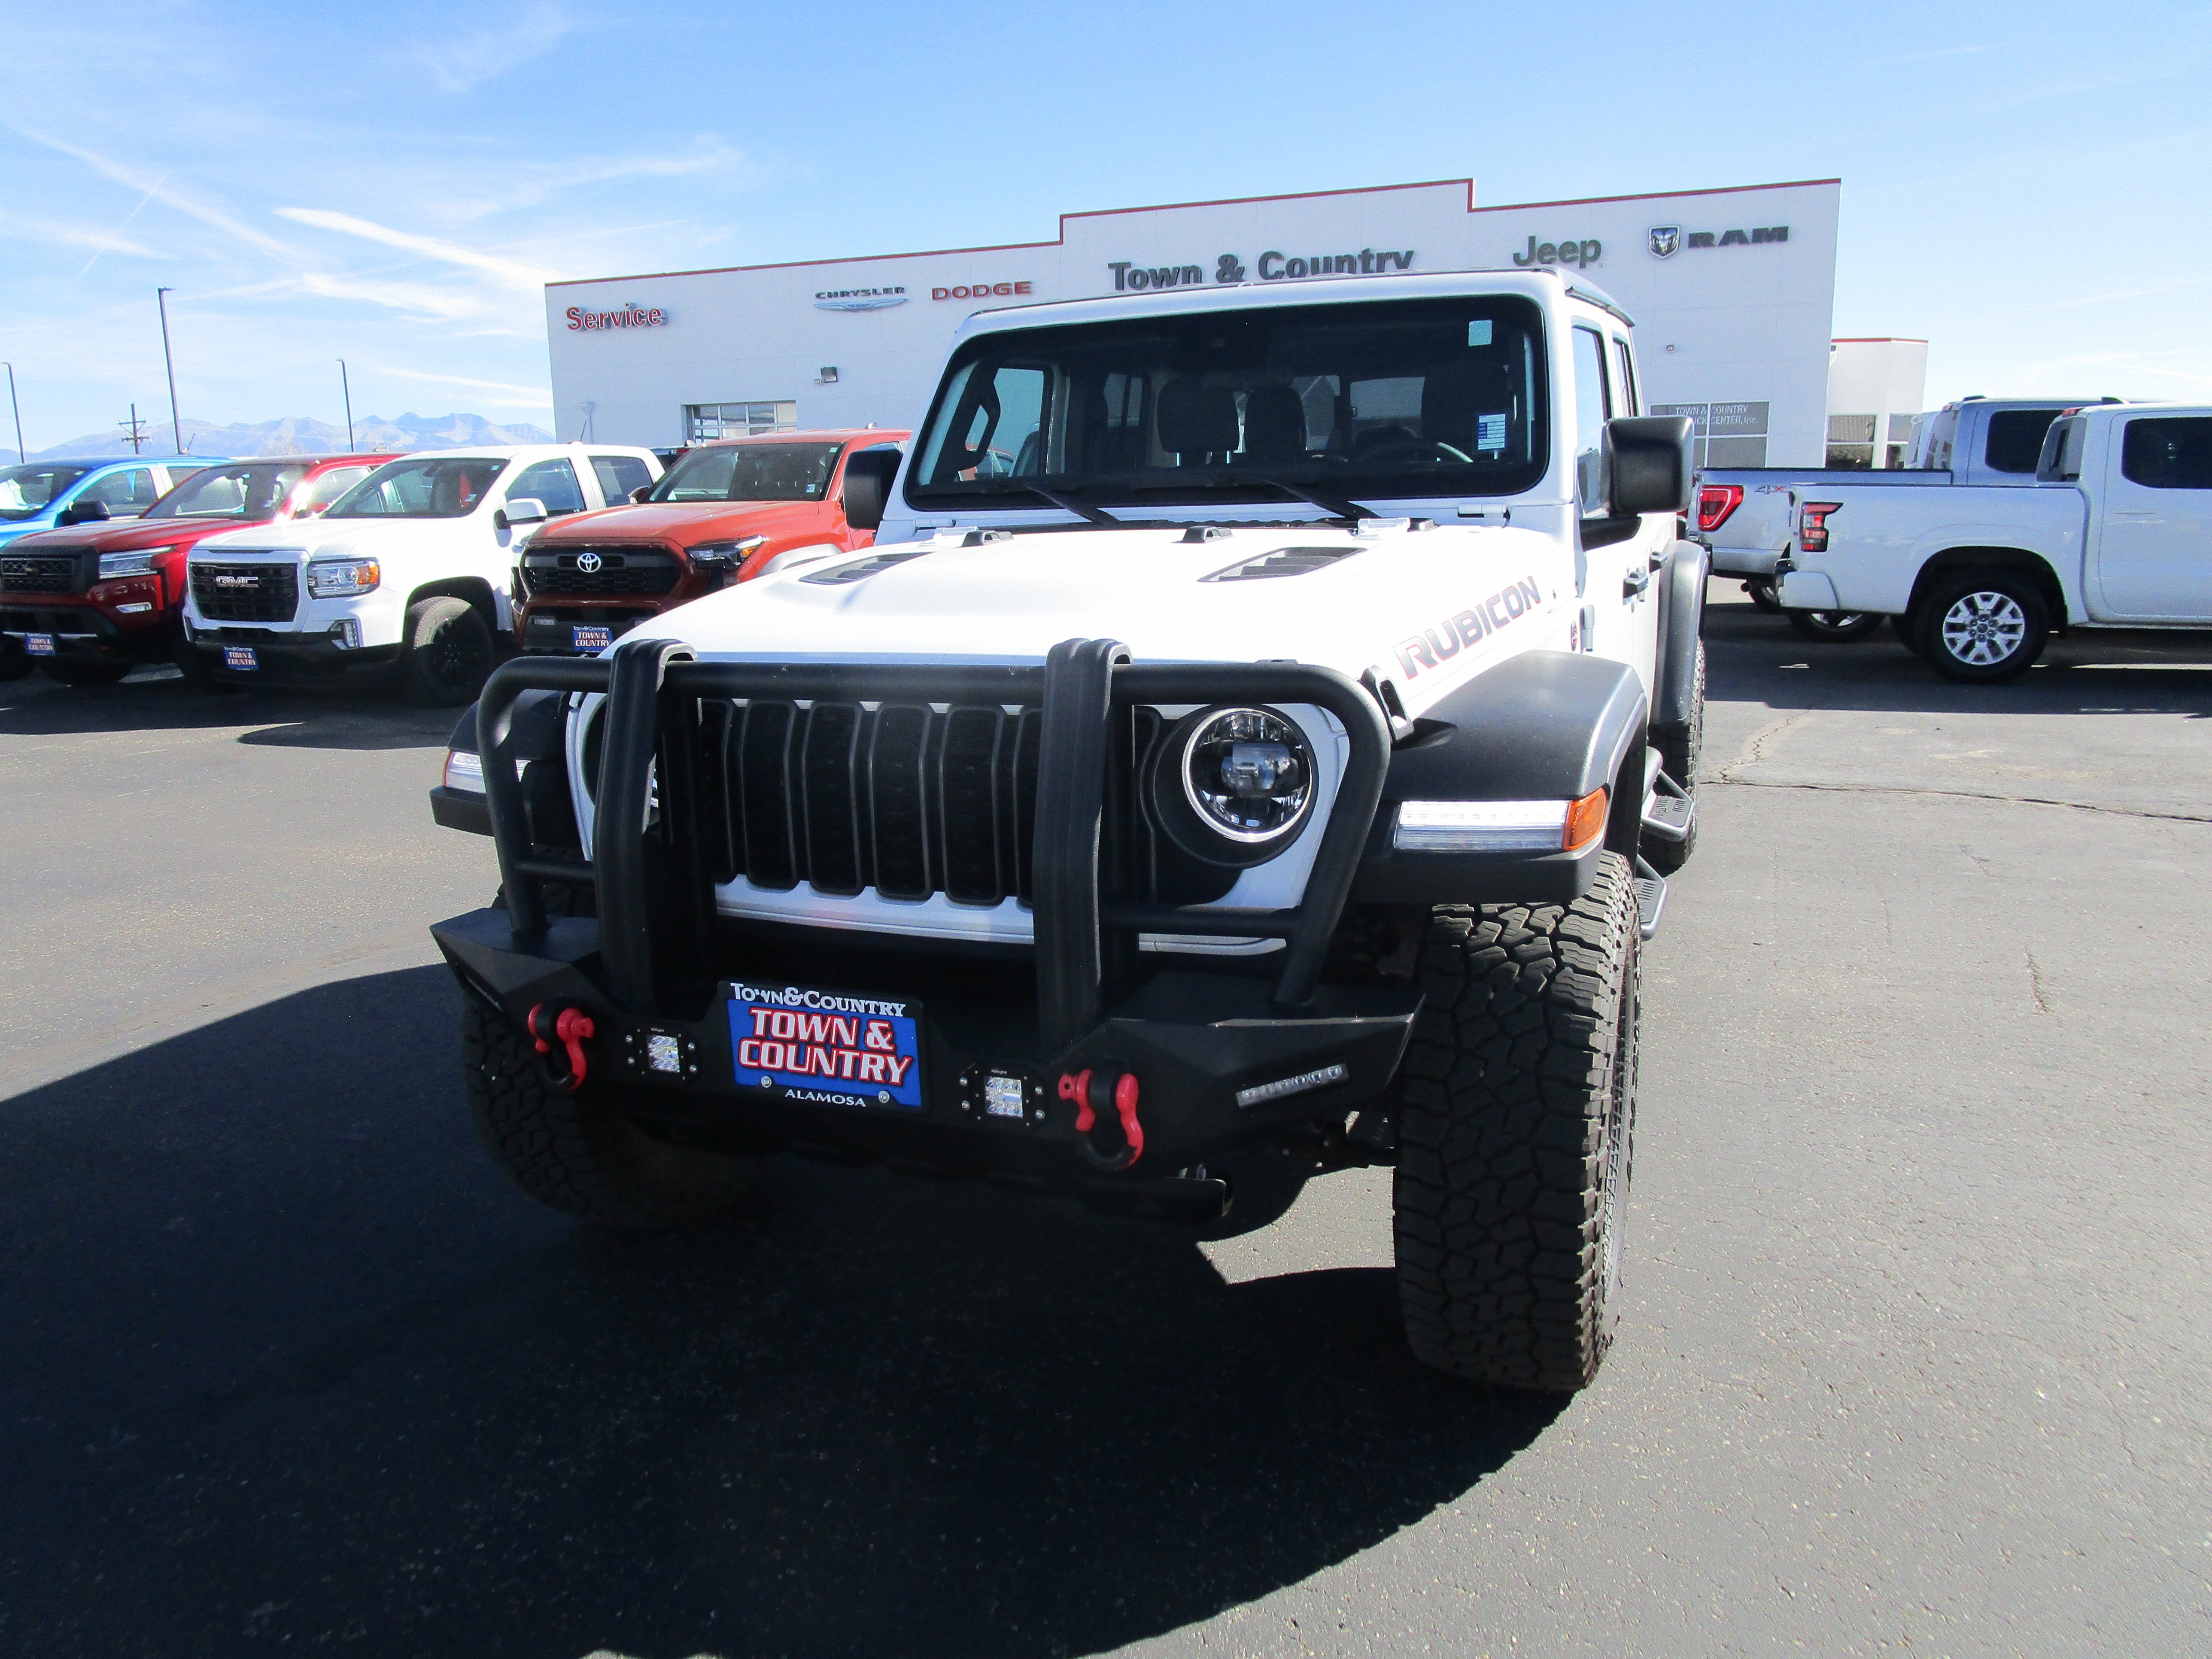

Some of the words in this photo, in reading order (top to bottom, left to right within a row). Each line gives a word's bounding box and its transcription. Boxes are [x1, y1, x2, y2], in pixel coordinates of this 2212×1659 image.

[1688, 226, 1789, 248] RAM
[1513, 235, 1602, 268] Jeep
[1108, 261, 1203, 291] Town
[1216, 254, 1245, 283] &
[1258, 248, 1414, 280] Country
[816, 286, 905, 299] CHRYSLER
[932, 281, 1032, 300] DODGE
[566, 302, 662, 330] Service
[1676, 406, 1699, 415] TOWN
[216, 576, 258, 587] GMC
[1391, 575, 1541, 680] RUBICON
[750, 1006, 860, 1047] TOWN
[865, 1020, 896, 1052] &
[738, 1038, 913, 1085] COUNTRY
[785, 1089, 866, 1107] ALAMOSA
